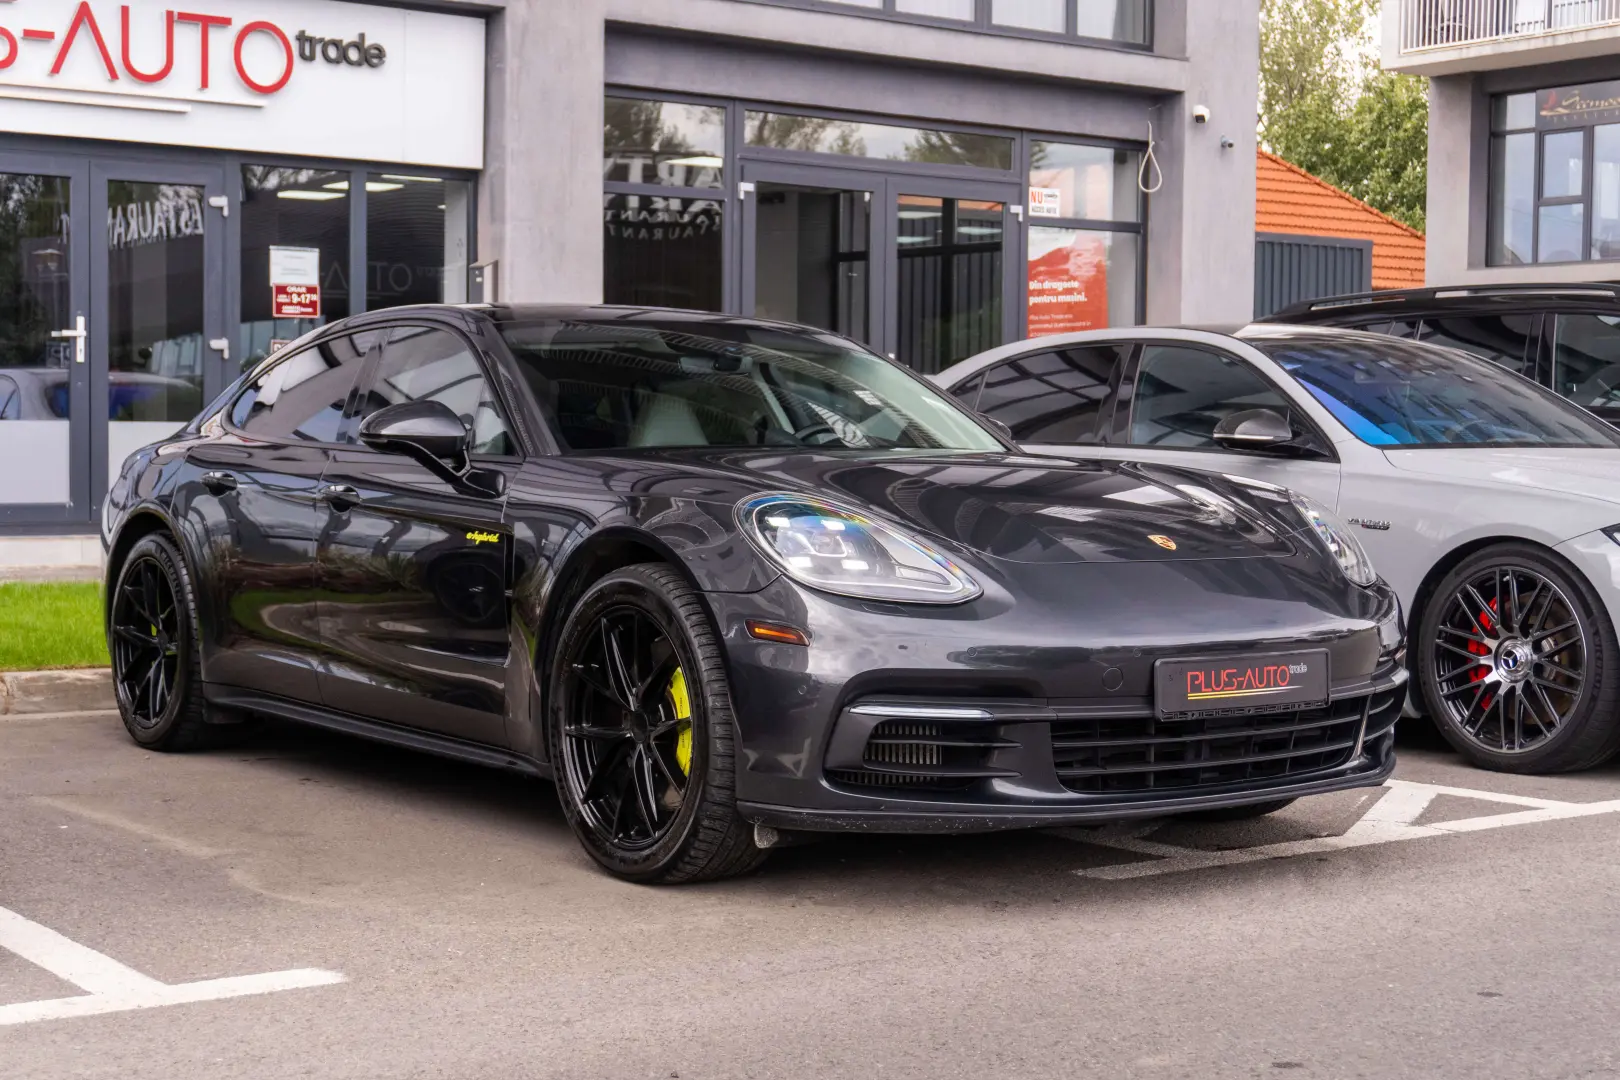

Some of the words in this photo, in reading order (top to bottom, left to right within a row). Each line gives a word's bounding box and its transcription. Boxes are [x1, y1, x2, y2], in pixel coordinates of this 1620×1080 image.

[296, 29, 386, 69] trade
[1031, 191, 1043, 204] NU
[1187, 664, 1290, 693] PLUS-AUTO
[1289, 662, 1308, 674] trade
